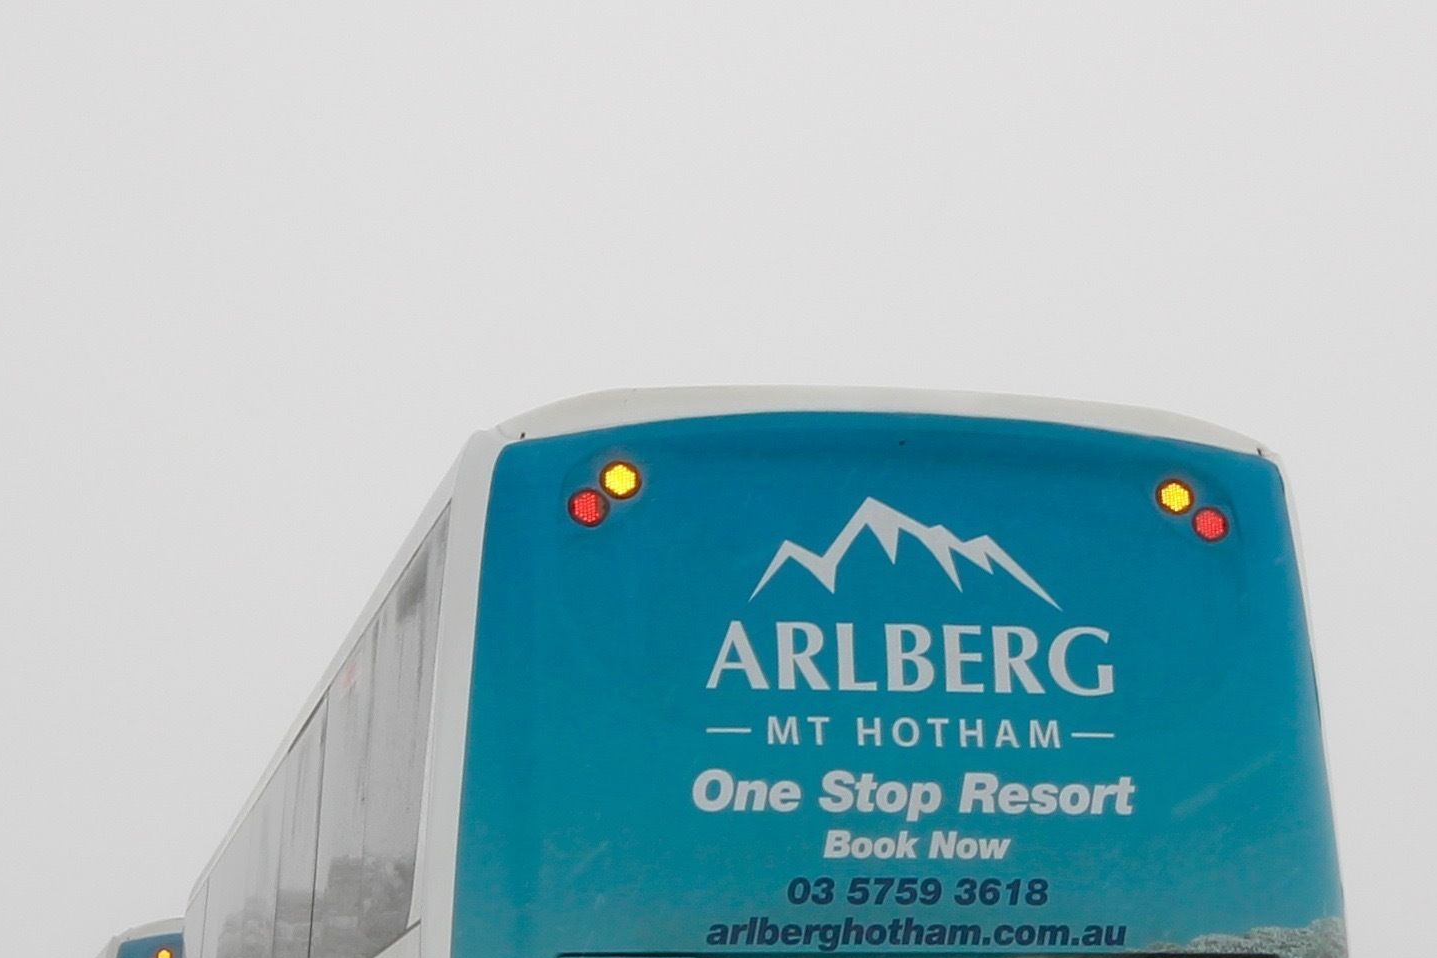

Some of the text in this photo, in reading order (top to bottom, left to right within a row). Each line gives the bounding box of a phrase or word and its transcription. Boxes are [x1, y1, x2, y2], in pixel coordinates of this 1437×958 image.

[706, 620, 1115, 696] ARLBERG
[767, 716, 1062, 748] MT HOTHAM
[691, 769, 1136, 821] One Stop Resort
[823, 830, 1011, 860] Book Now
[787, 877, 1049, 906] 03 5759 3618
[706, 917, 1127, 951] arlberghotham.com.au
